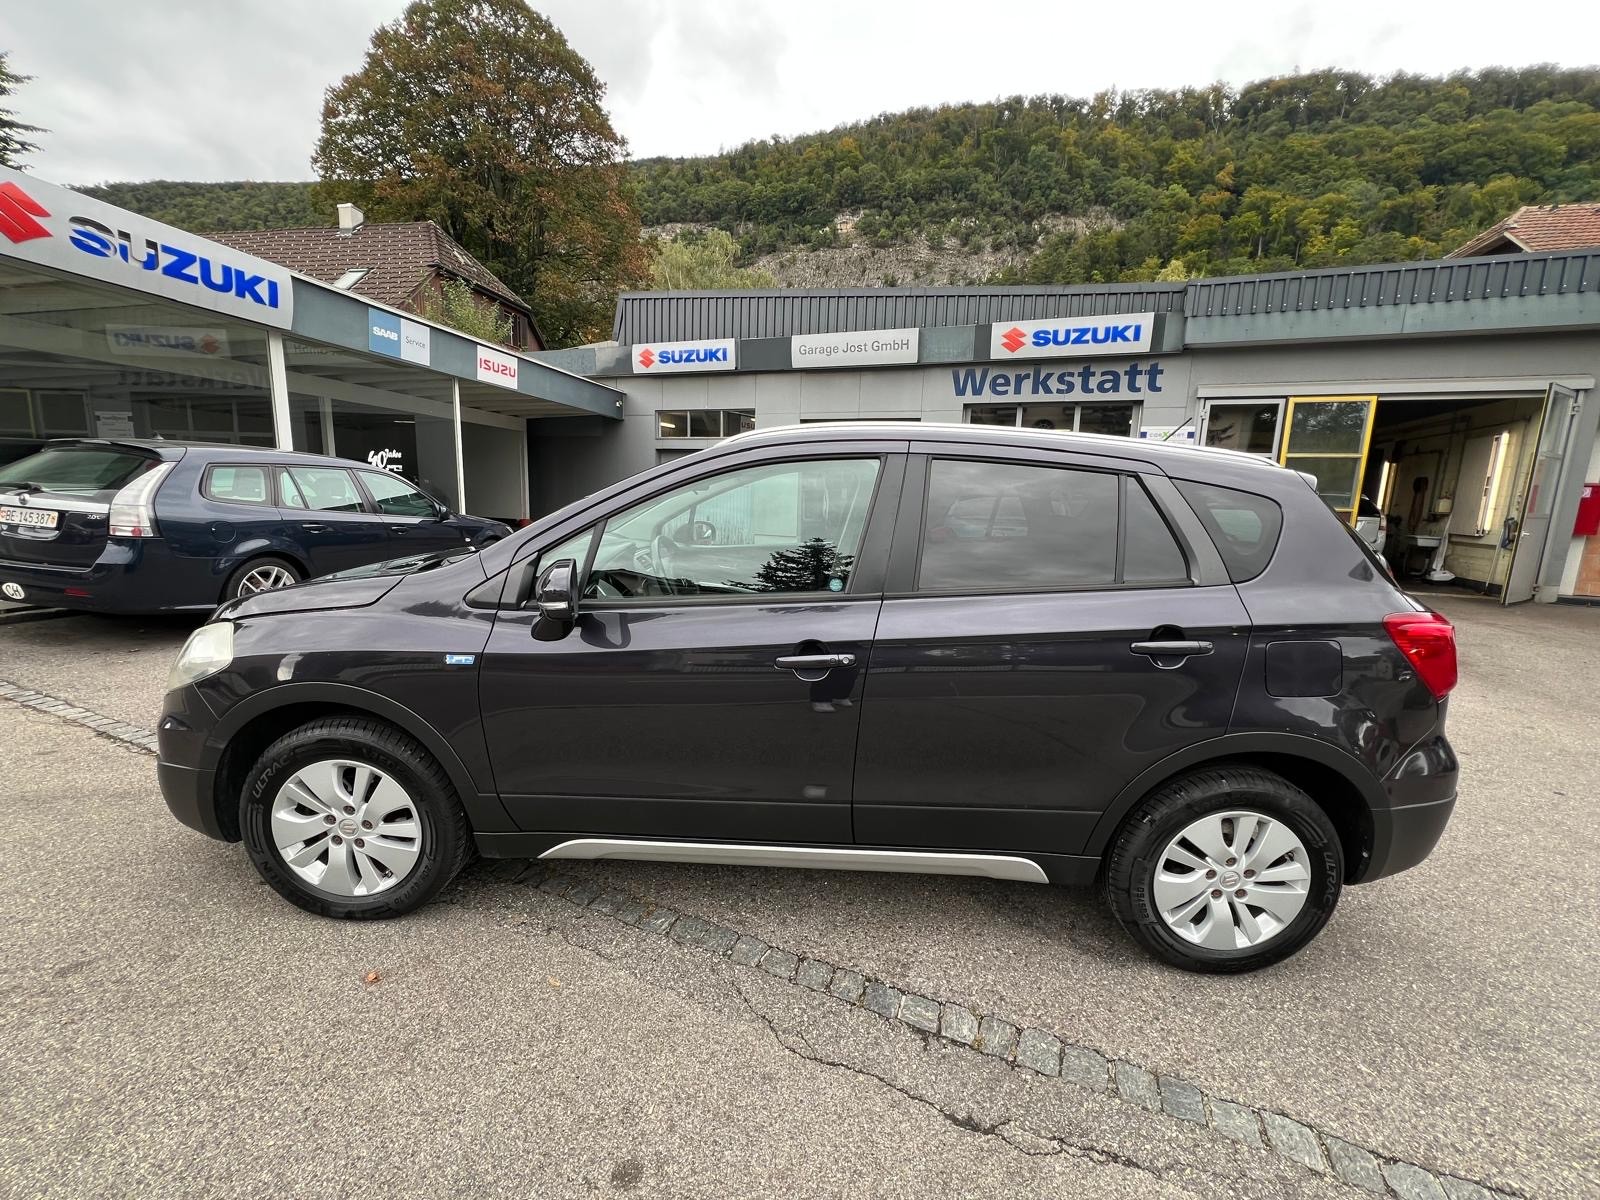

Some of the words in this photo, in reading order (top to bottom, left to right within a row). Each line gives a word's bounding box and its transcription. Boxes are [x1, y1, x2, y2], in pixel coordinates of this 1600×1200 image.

[68, 216, 279, 309] SUZUKI
[372, 326, 398, 341] SAAB
[405, 336, 426, 349] Service
[1032, 324, 1142, 347] SUZUKI
[658, 347, 728, 364] SUZUKI
[798, 344, 839, 357] Garage
[842, 342, 868, 353] Jost
[871, 338, 910, 352] GmbH
[479, 357, 516, 378] ISUZU
[952, 361, 1164, 397] Werkstatt
[368, 450, 387, 467] 40
[5, 584, 22, 598] CH
[1323, 851, 1337, 906] ULTRAC
